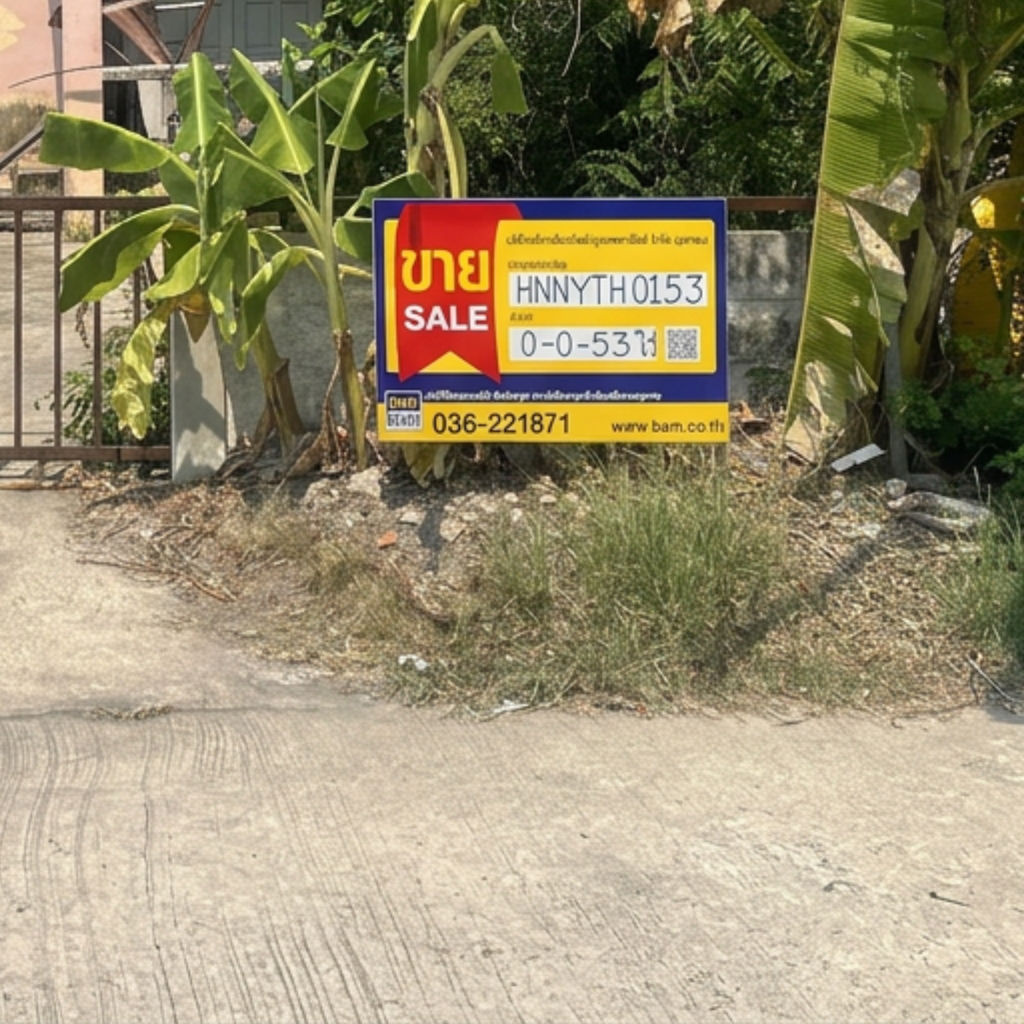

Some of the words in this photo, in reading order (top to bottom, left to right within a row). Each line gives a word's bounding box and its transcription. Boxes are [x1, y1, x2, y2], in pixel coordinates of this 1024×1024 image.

[401, 249, 489, 292] ขาย
[404, 305, 489, 331] SALE
[432, 412, 570, 435] 036-221871
